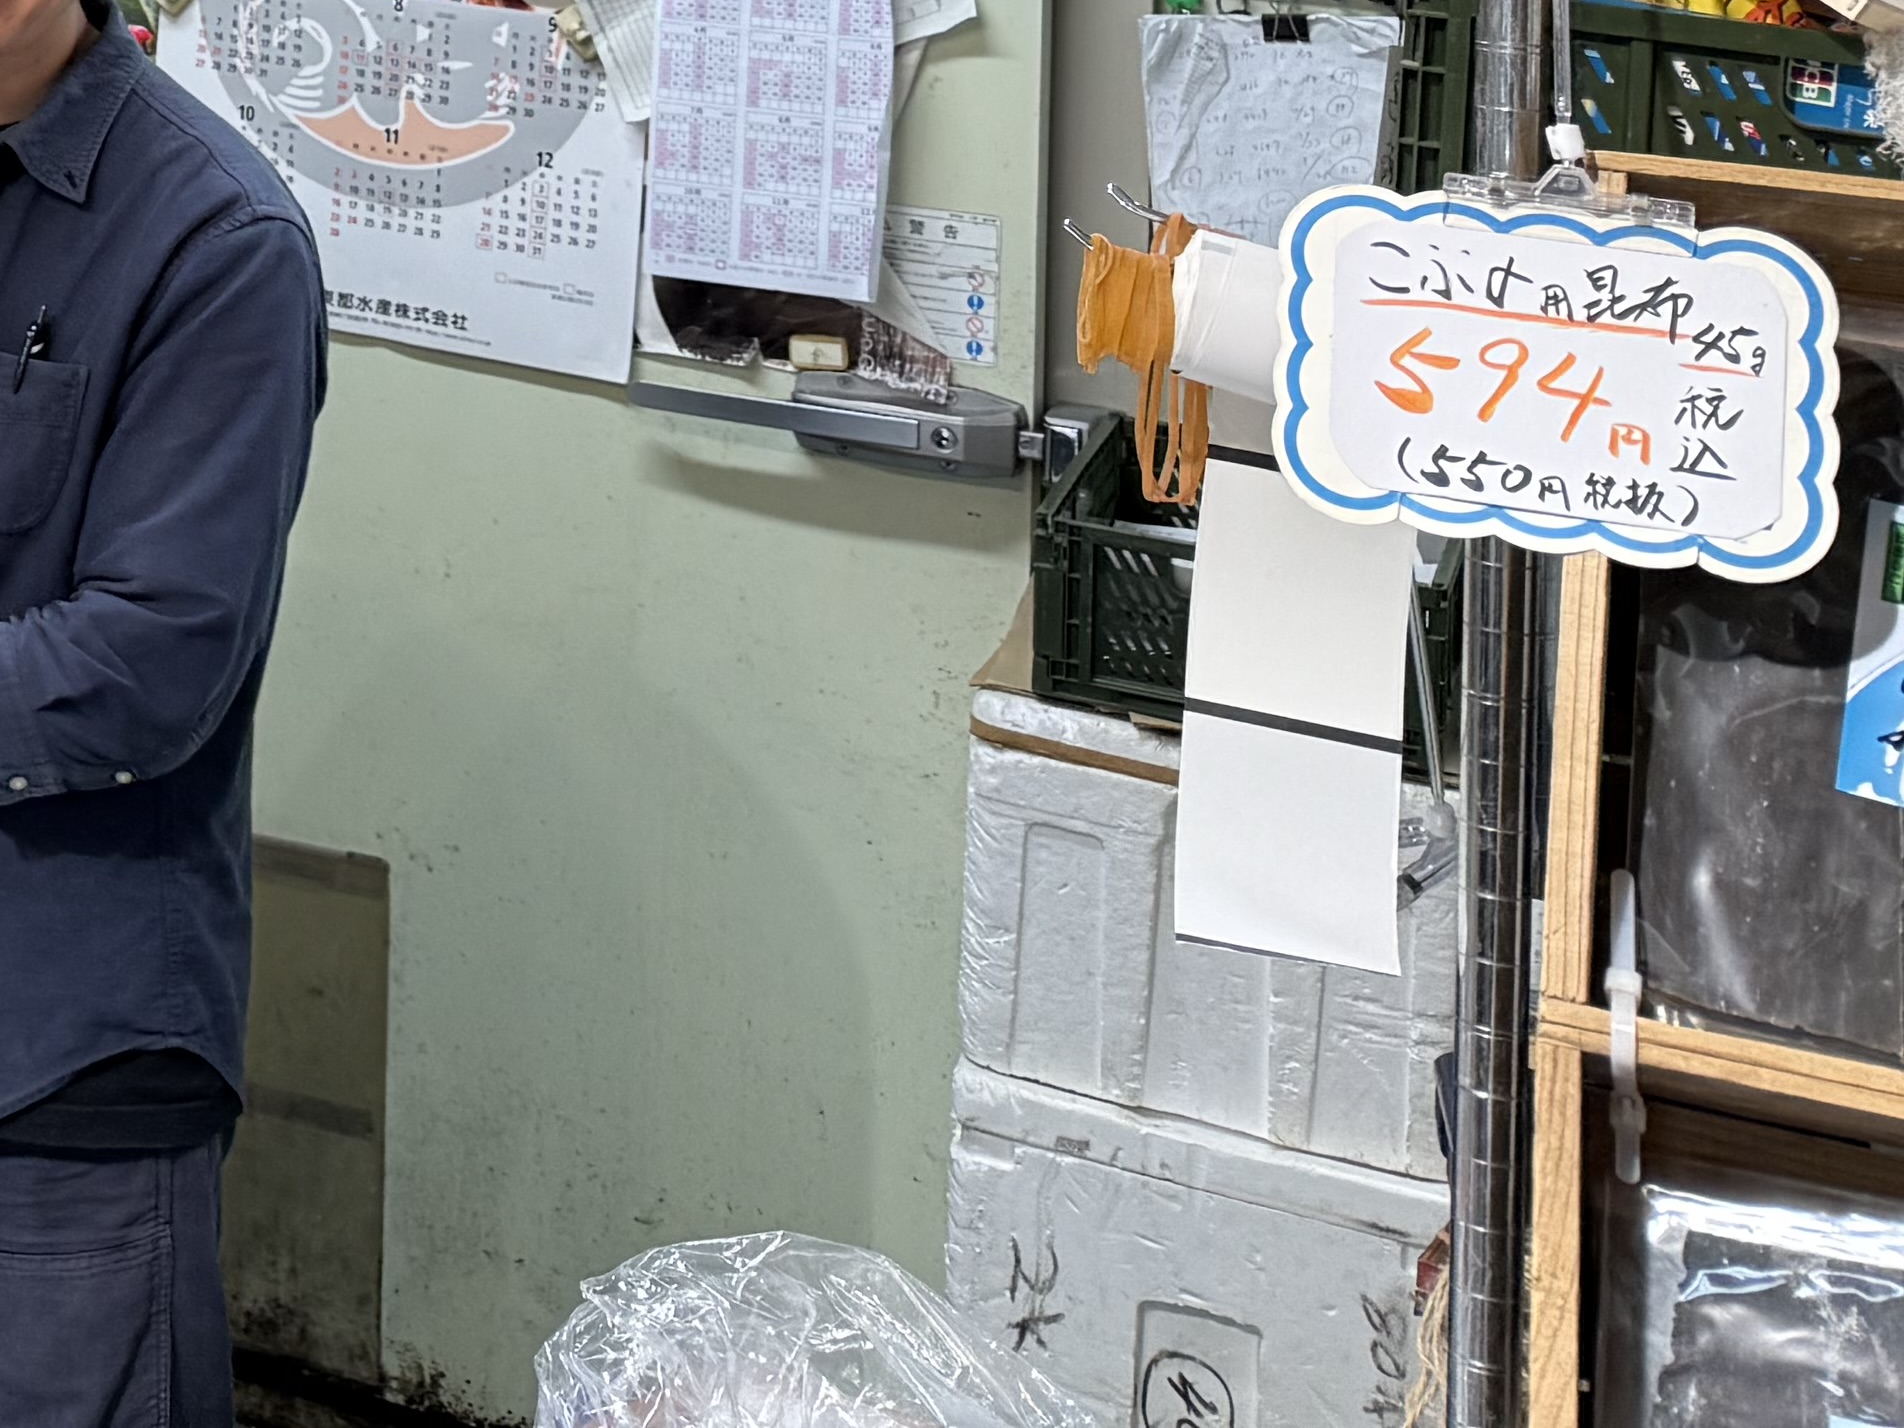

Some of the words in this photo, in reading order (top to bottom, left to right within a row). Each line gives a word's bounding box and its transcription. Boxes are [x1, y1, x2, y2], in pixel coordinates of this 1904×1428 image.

[238, 105, 255, 121] 10
[384, 128, 399, 144] 11
[536, 152, 554, 169] 12
[1689, 321, 1769, 376] 45g
[1373, 323, 1652, 468] 594円
[1671, 382, 1747, 484] 税込
[1395, 438, 1701, 529] (550円税抜)
